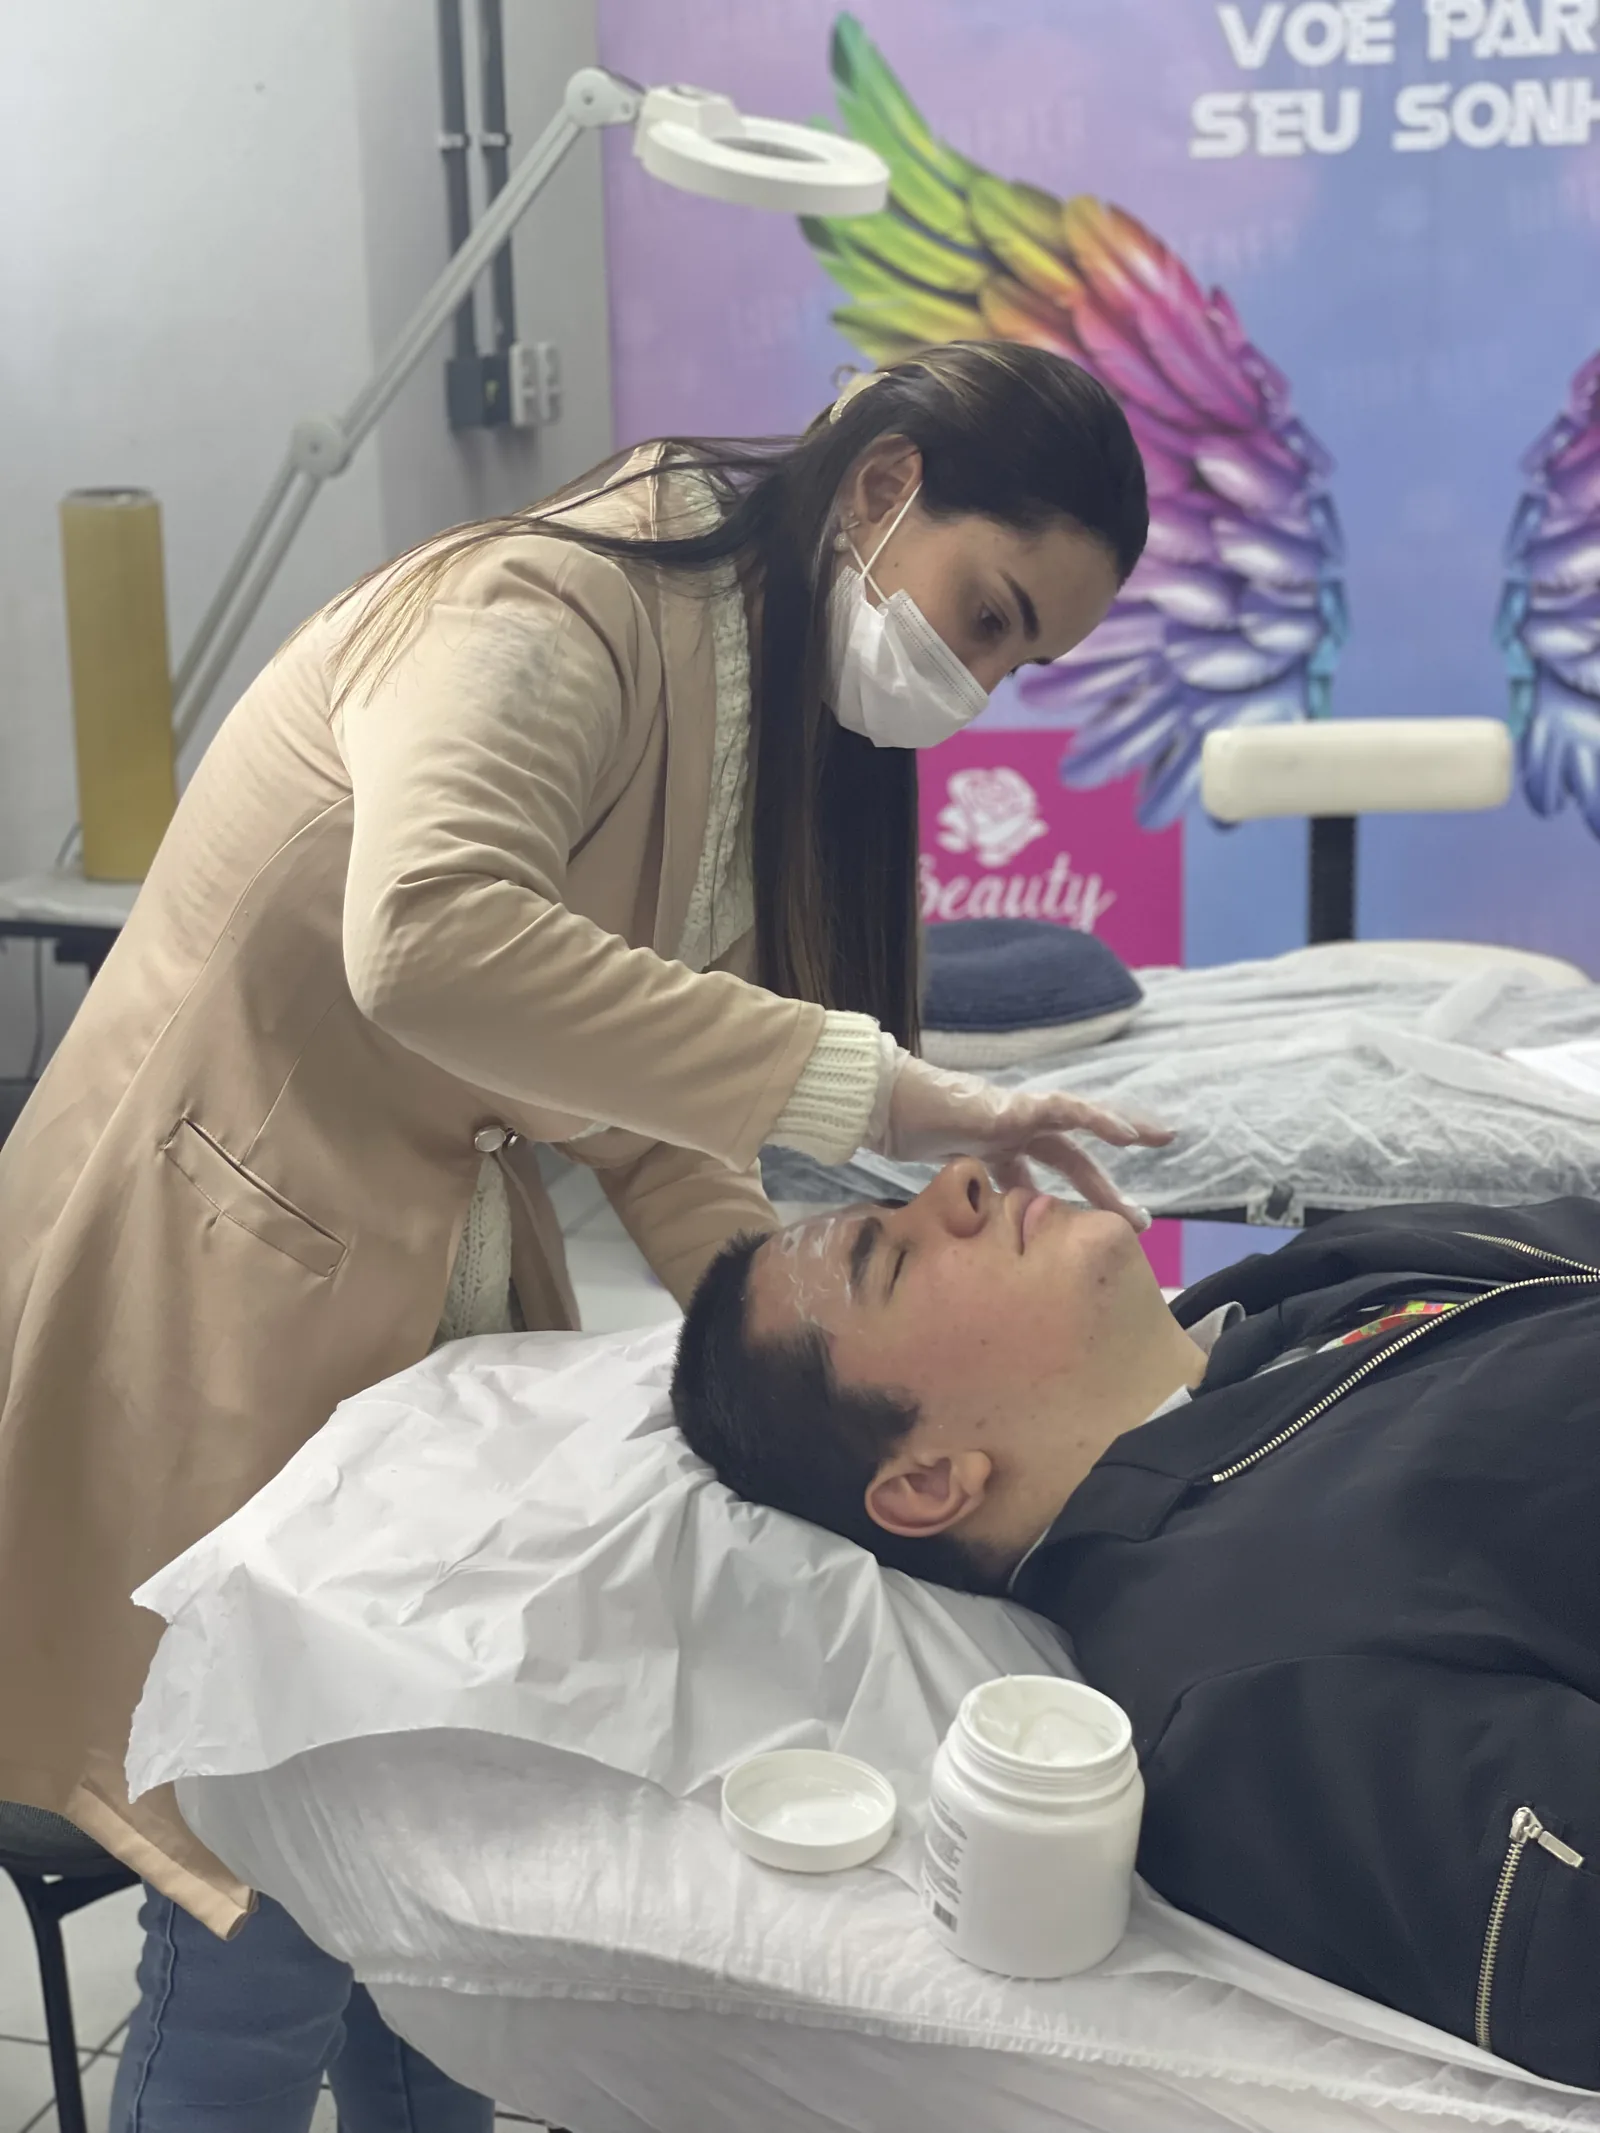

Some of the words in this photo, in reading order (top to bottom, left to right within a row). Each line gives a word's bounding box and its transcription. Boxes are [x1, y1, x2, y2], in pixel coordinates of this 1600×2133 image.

[1216, 0, 1395, 69] VOE
[1425, 0, 1598, 62] PAR
[1188, 86, 1362, 158] SEU
